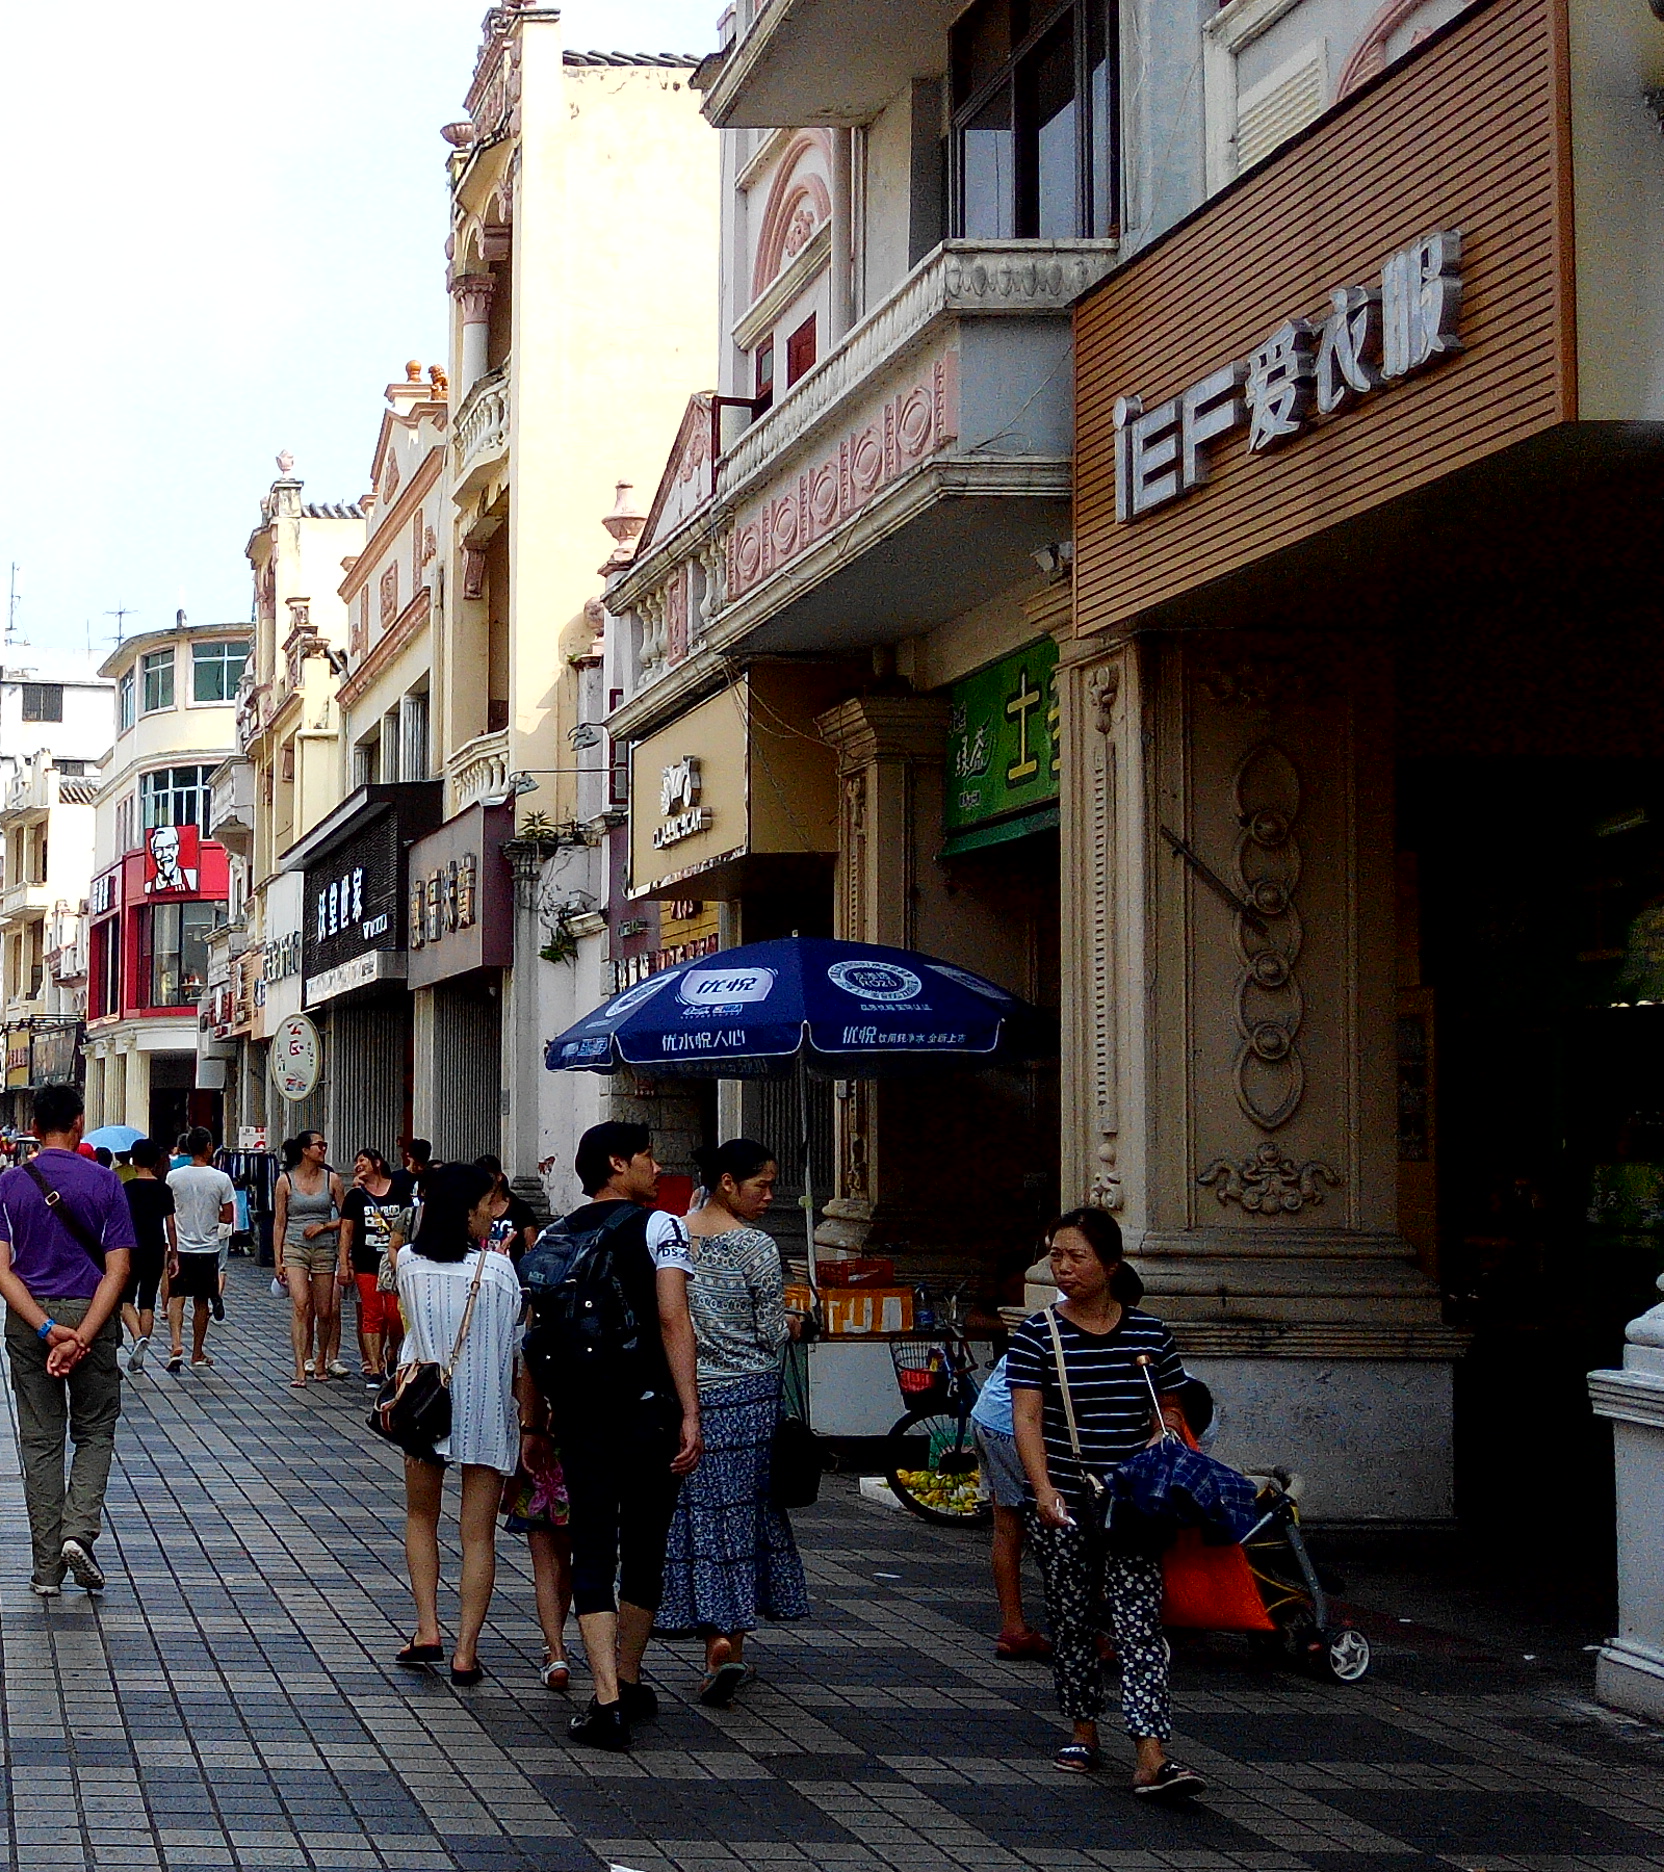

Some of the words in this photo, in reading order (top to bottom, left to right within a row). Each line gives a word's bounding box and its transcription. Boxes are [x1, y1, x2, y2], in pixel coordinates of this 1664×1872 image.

[1244, 230, 1454, 454] 爱衣服
[696, 977, 758, 995] 优悦
[661, 1029, 746, 1052] 优水悦人心
